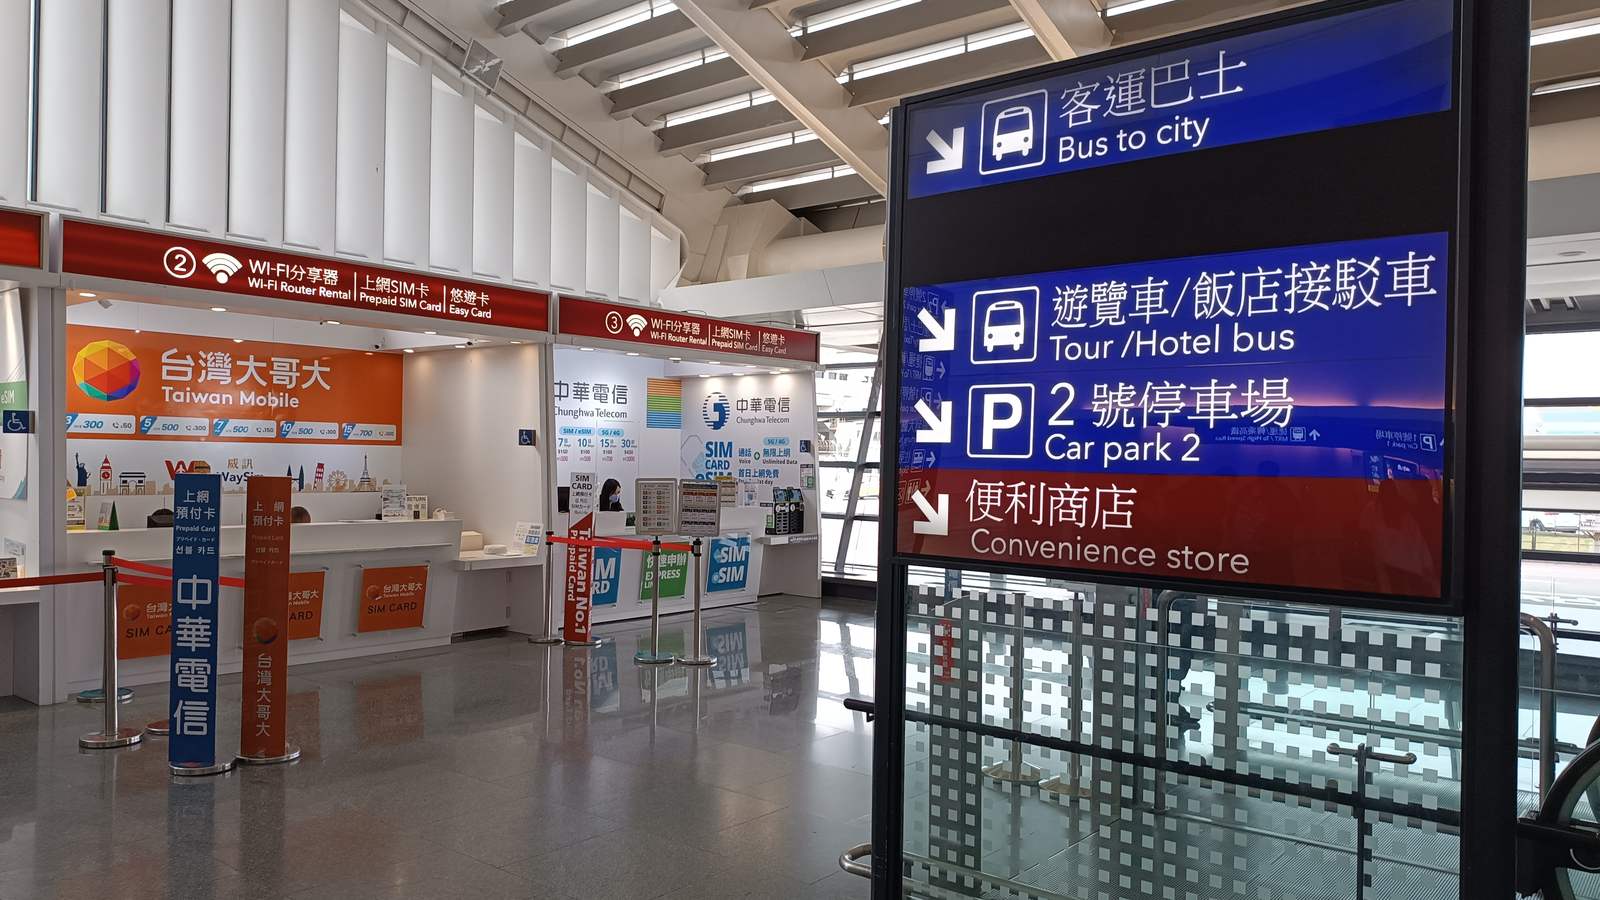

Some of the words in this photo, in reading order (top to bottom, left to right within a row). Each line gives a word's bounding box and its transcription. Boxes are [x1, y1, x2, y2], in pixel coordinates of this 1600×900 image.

[1059, 50, 1248, 128] 客運巴士
[1059, 135, 1108, 163] Bus
[1117, 129, 1146, 153] to
[1156, 115, 1210, 147] city
[249, 259, 339, 286] WI-FI分享器
[248, 276, 278, 291] WI-FI
[280, 282, 317, 296] Router
[319, 287, 352, 300] Rental
[360, 274, 430, 299] 上網SIM卡
[1050, 251, 1437, 330] 遊覽車/飯店接駁車
[360, 292, 397, 306] Prepaid
[399, 297, 417, 308] SIM
[419, 301, 442, 312] Card
[450, 288, 490, 307] 悠遊卡
[449, 305, 470, 318] Easy
[471, 307, 492, 319] Card
[650, 330, 668, 340] WI-FI
[668, 333, 688, 343] Router
[689, 335, 707, 345] Rental
[712, 325, 751, 341] 上網SIM卡
[762, 332, 786, 346] 悠遊卡
[711, 338, 733, 349] Prepaid
[733, 341, 744, 349] SIM
[745, 342, 758, 351] Card
[762, 345, 773, 354] Easy
[773, 346, 787, 354] Card
[1049, 335, 1113, 361] Tour
[1121, 325, 1222, 358] /Hotel
[1233, 323, 1296, 353] bus
[161, 347, 331, 390] 台灣大哥大
[161, 386, 233, 405] Taiwan
[239, 390, 300, 408] Mobile
[554, 380, 628, 405] 中華電信
[595, 407, 628, 418] Telecom
[736, 397, 790, 413] 中華電信
[83, 420, 103, 429] 300
[145, 418, 151, 426] 5
[161, 423, 179, 431] 500
[736, 416, 766, 425] Chunghwa
[233, 425, 249, 433] 500
[578, 438, 587, 447] 10
[600, 439, 610, 447] 15
[621, 439, 631, 448] 30
[705, 441, 733, 458] SIM
[1045, 435, 1094, 460] Car
[1103, 434, 1172, 467] park
[1181, 434, 1201, 461] 2
[705, 460, 730, 470] CARD
[184, 490, 209, 503] 上網
[965, 479, 1137, 529] 便利商店
[176, 506, 216, 520] 預付卡
[175, 525, 200, 533] Prepaid
[970, 529, 1156, 567] Convenience
[1166, 544, 1250, 574] store
[567, 576, 576, 601] Card
[368, 605, 385, 615] SIM
[389, 601, 417, 612] CARD
[126, 627, 150, 638] SIM
[173, 574, 212, 736] 中華電信
[255, 653, 273, 737] 台灣大哥大
